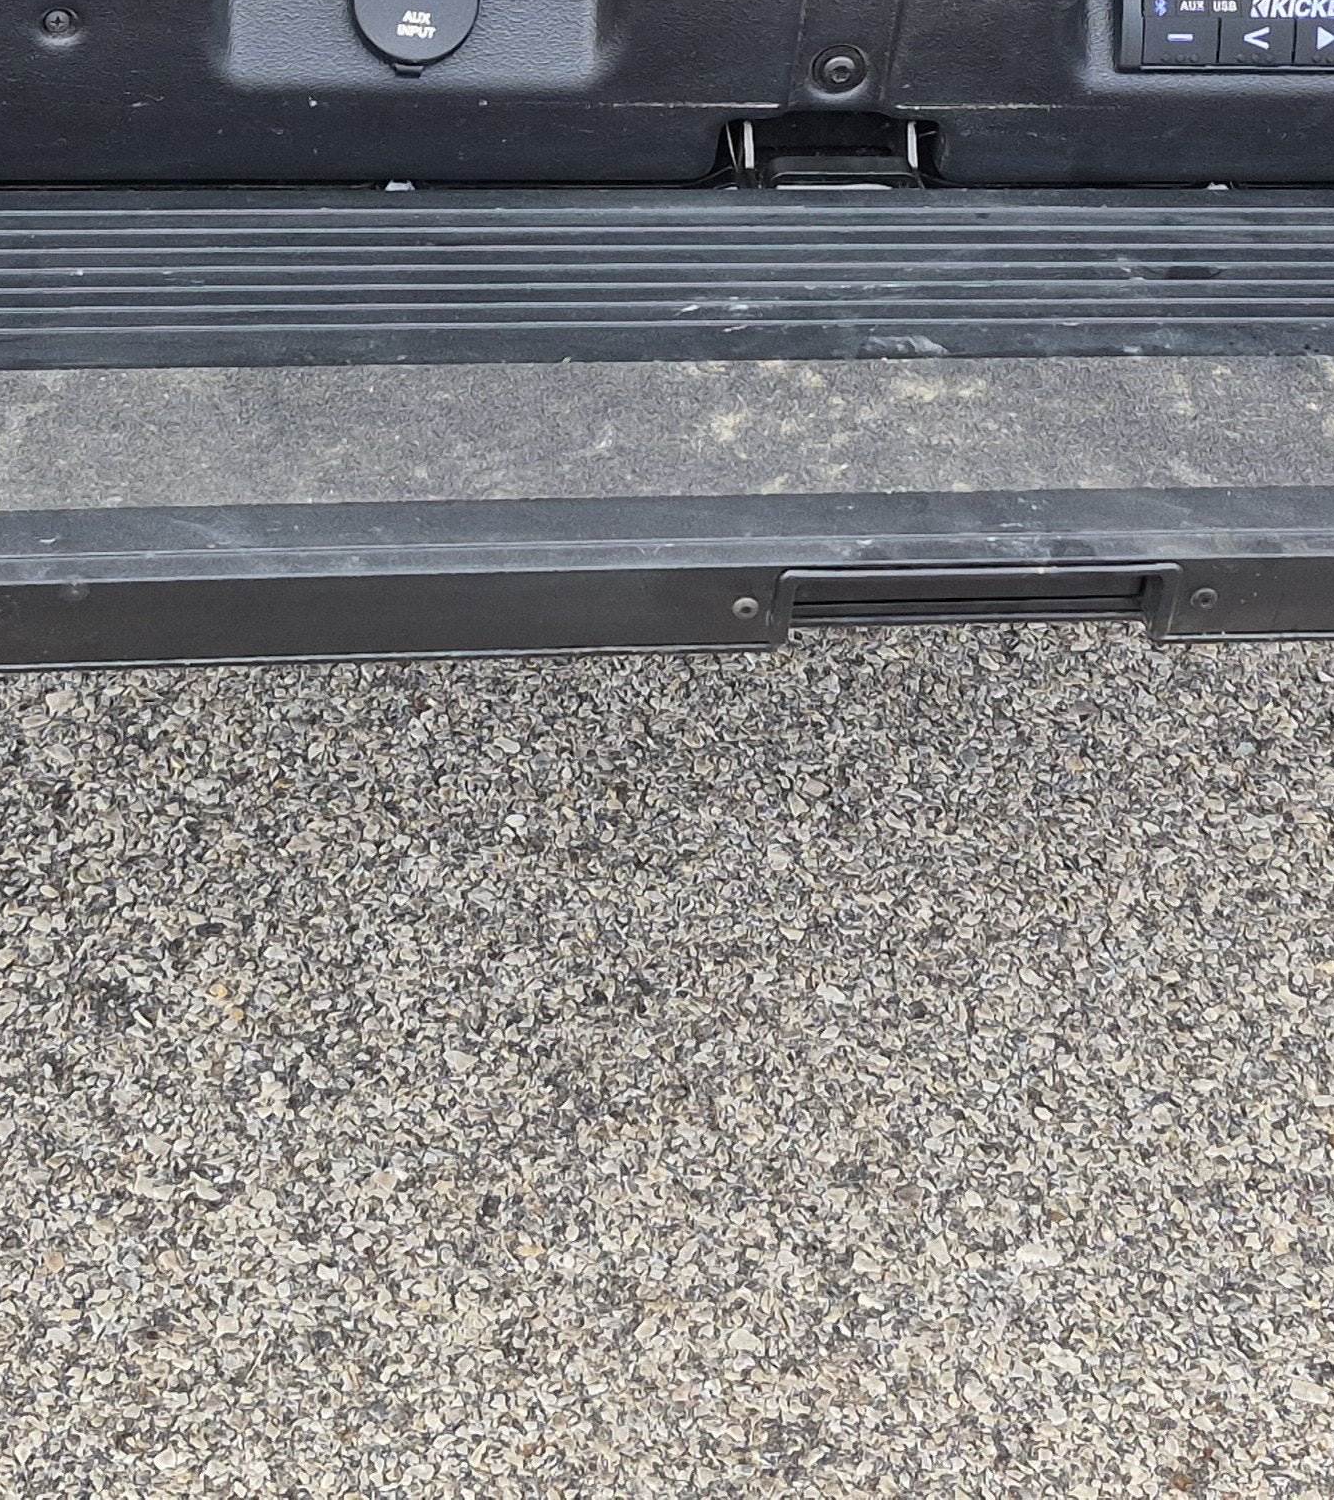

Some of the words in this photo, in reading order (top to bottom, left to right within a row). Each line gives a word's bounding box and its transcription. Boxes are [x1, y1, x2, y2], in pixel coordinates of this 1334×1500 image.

[1179, 0, 1205, 12] AUX
[1212, 0, 1238, 12] USB
[402, 10, 431, 25] AUX
[396, 24, 437, 39] INPUT
